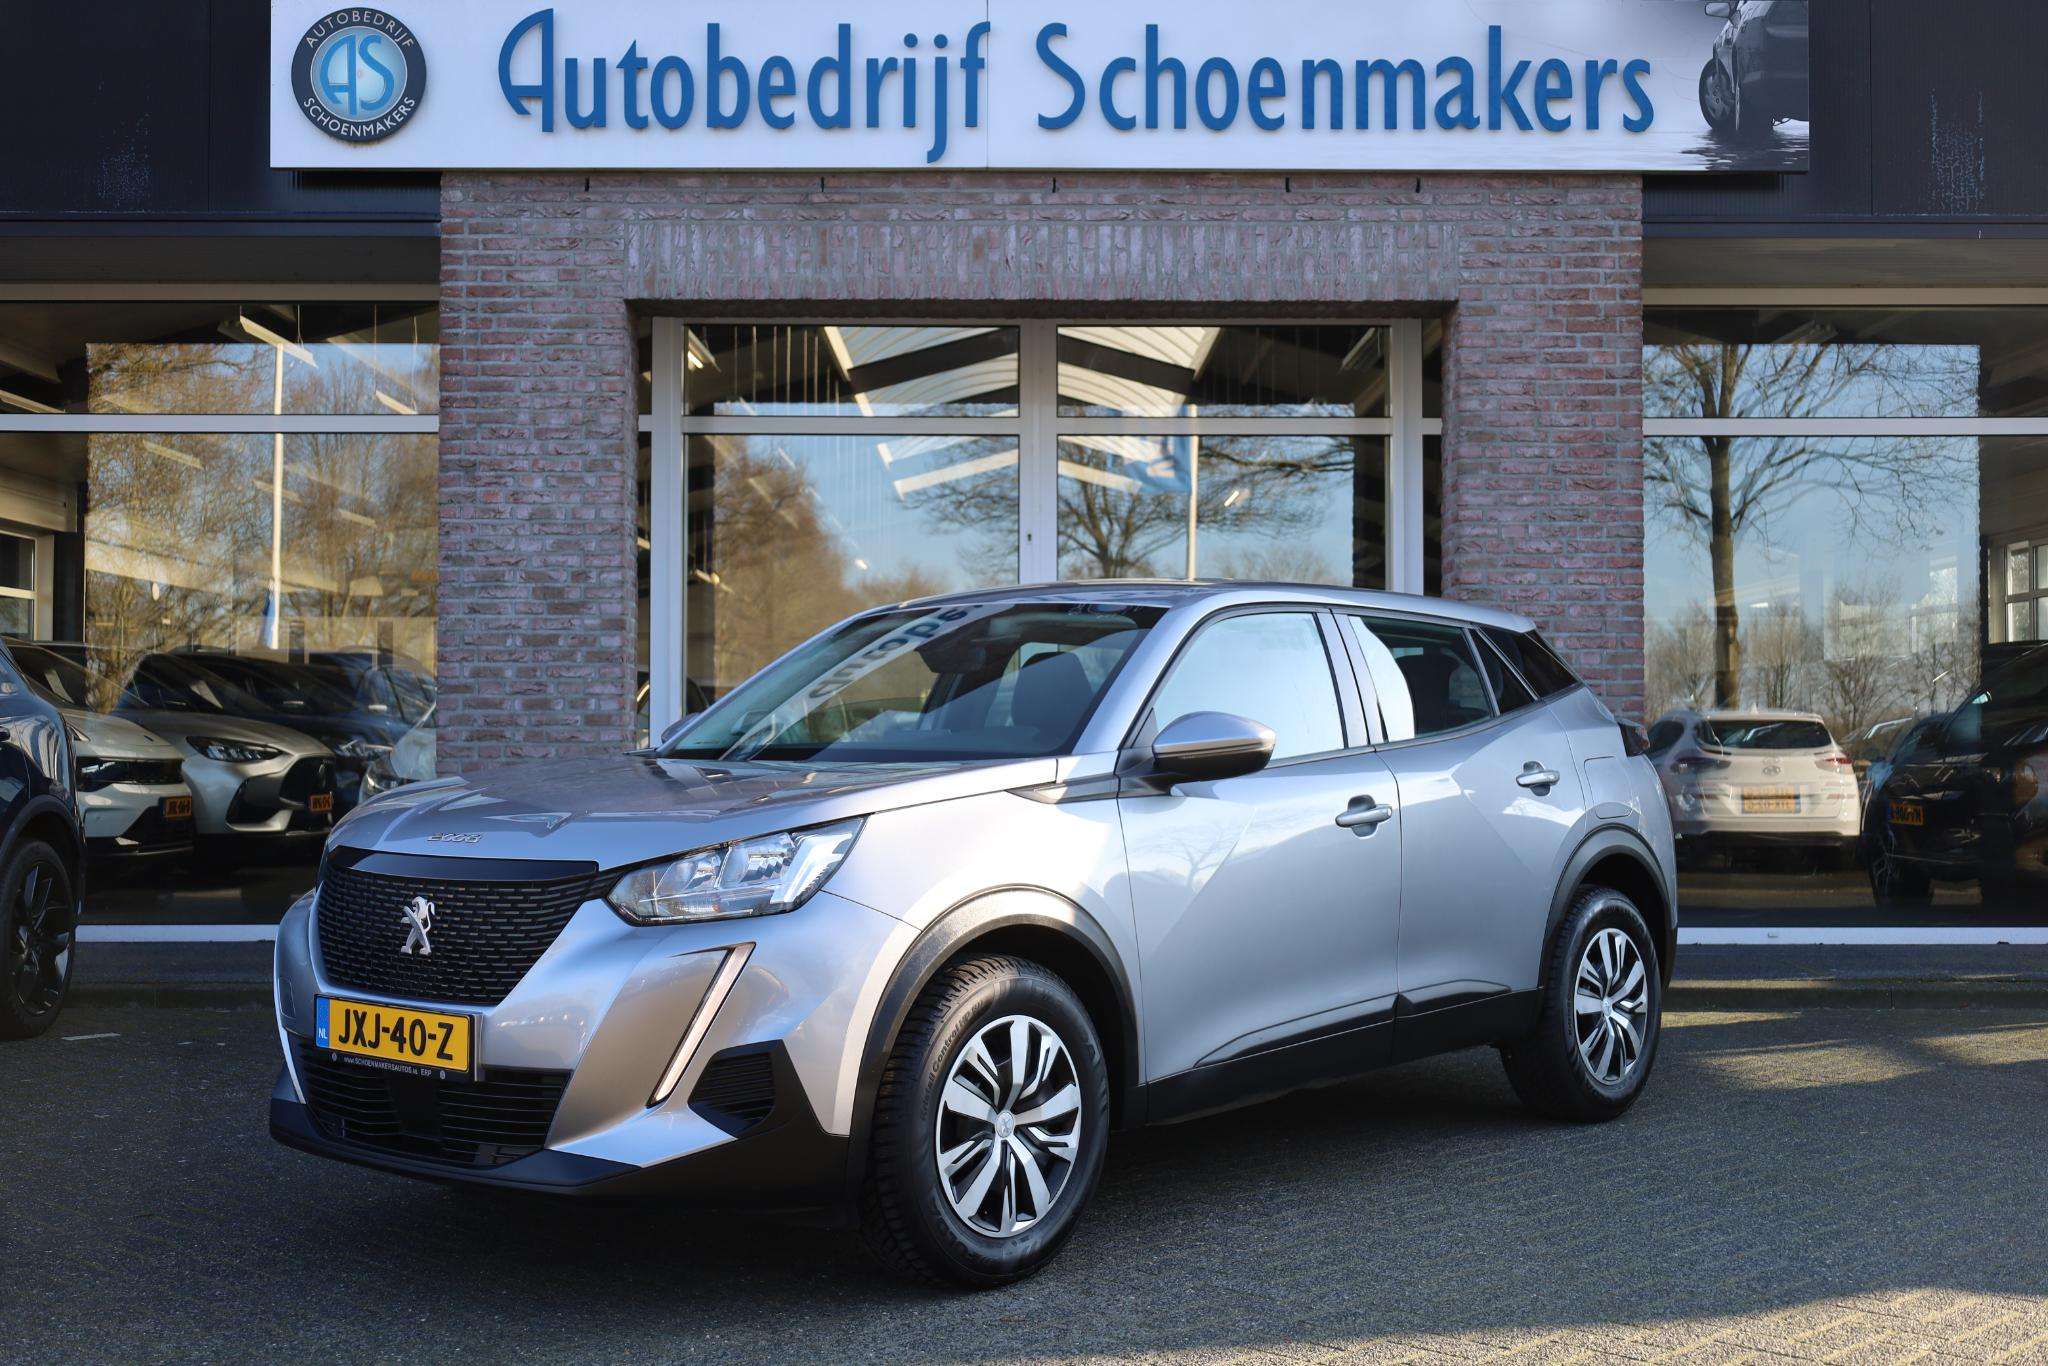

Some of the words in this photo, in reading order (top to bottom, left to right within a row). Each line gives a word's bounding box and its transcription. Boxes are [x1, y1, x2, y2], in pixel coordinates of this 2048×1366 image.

[305, 10, 414, 49] AUTOBEDRIJF
[320, 33, 395, 117] AS
[498, 8, 991, 164] Autobedrijf
[1036, 22, 1654, 132] Schoenmakers
[303, 96, 416, 137] SCHOENMAKERS
[318, 1027, 328, 1039] NL
[338, 1008, 454, 1061] JXJ-40-Z
